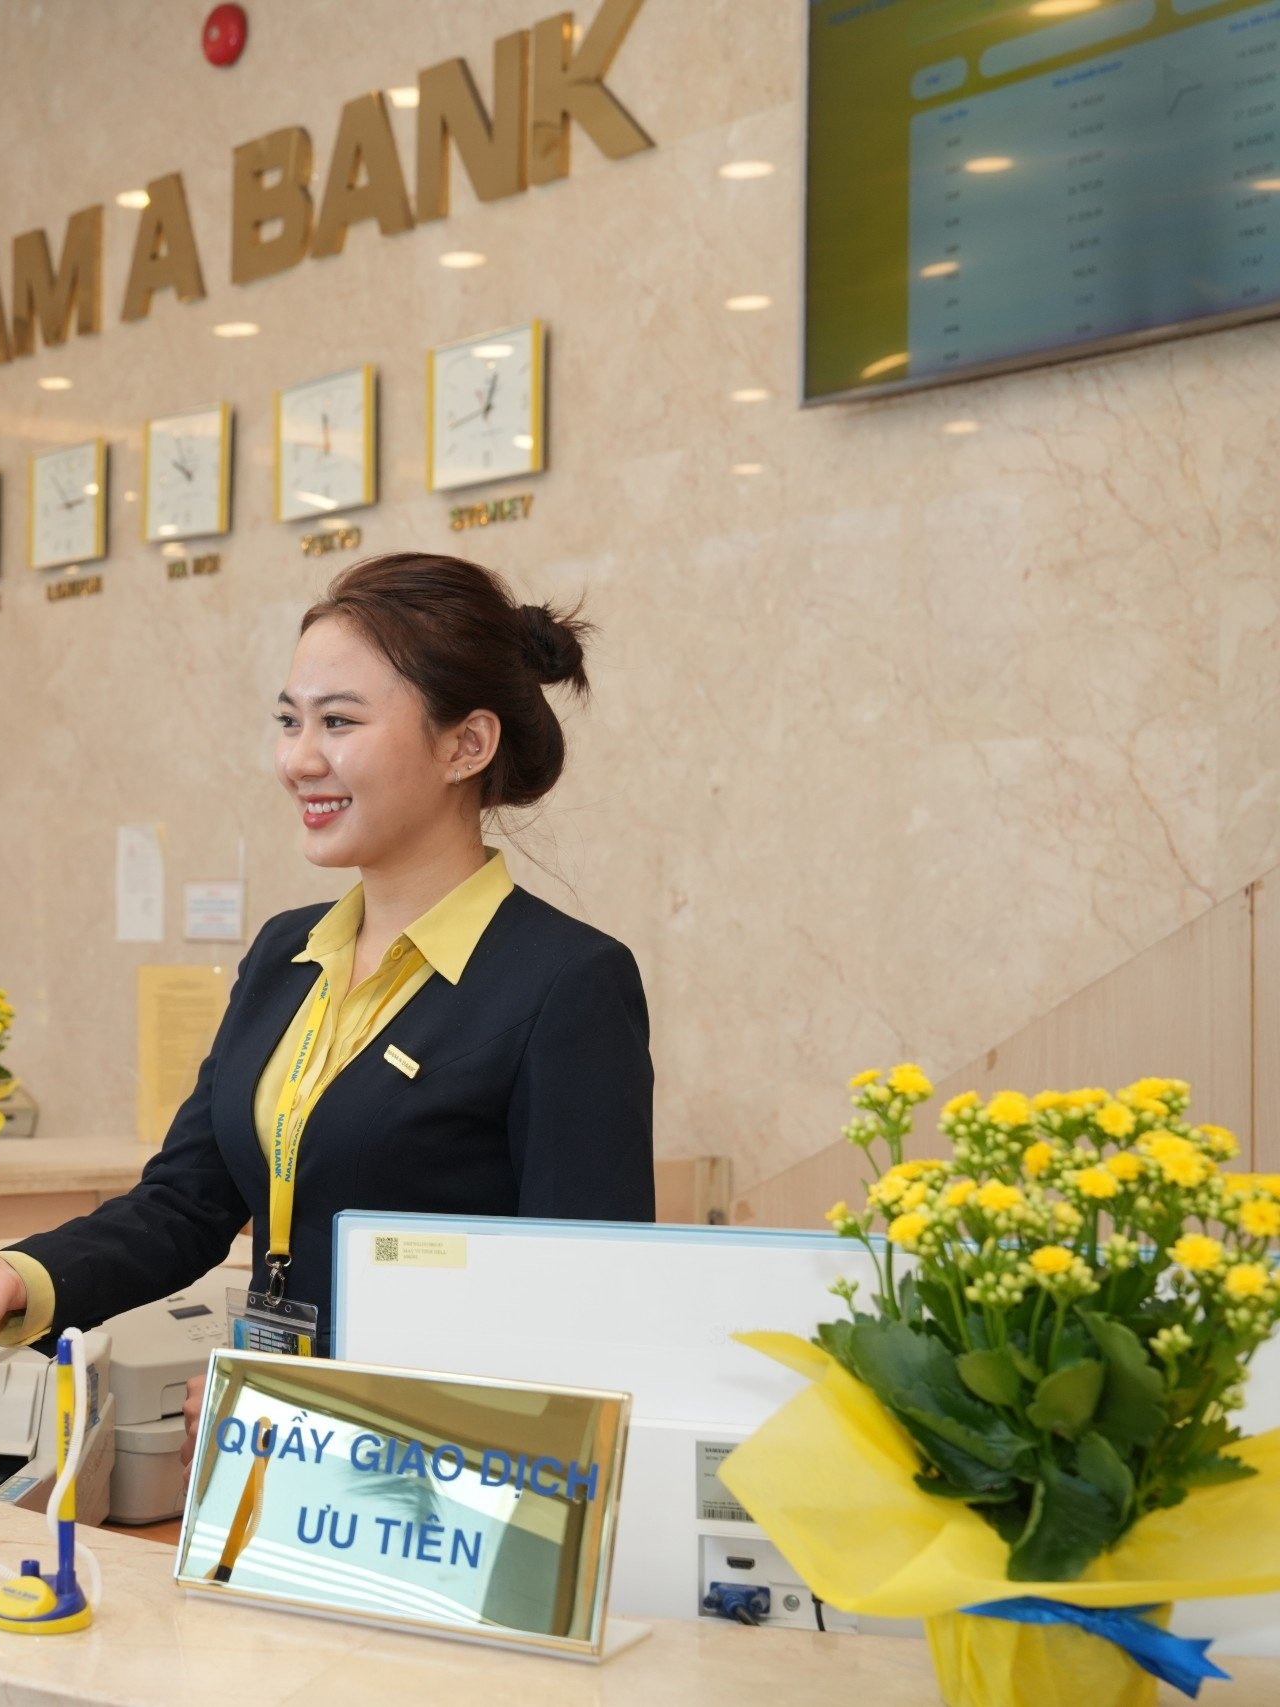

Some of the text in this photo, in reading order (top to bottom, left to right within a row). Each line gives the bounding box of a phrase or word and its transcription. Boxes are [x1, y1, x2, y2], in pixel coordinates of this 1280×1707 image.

[121, 171, 207, 323] A
[231, 0, 657, 285] BANK
[301, 1029, 314, 1050] NAM
[290, 1059, 304, 1083] BANK
[275, 1113, 285, 1138] NAM
[216, 1411, 600, 1501] QUẦY GIAO DỊCH
[296, 1504, 483, 1568] ƯU TIÊN
